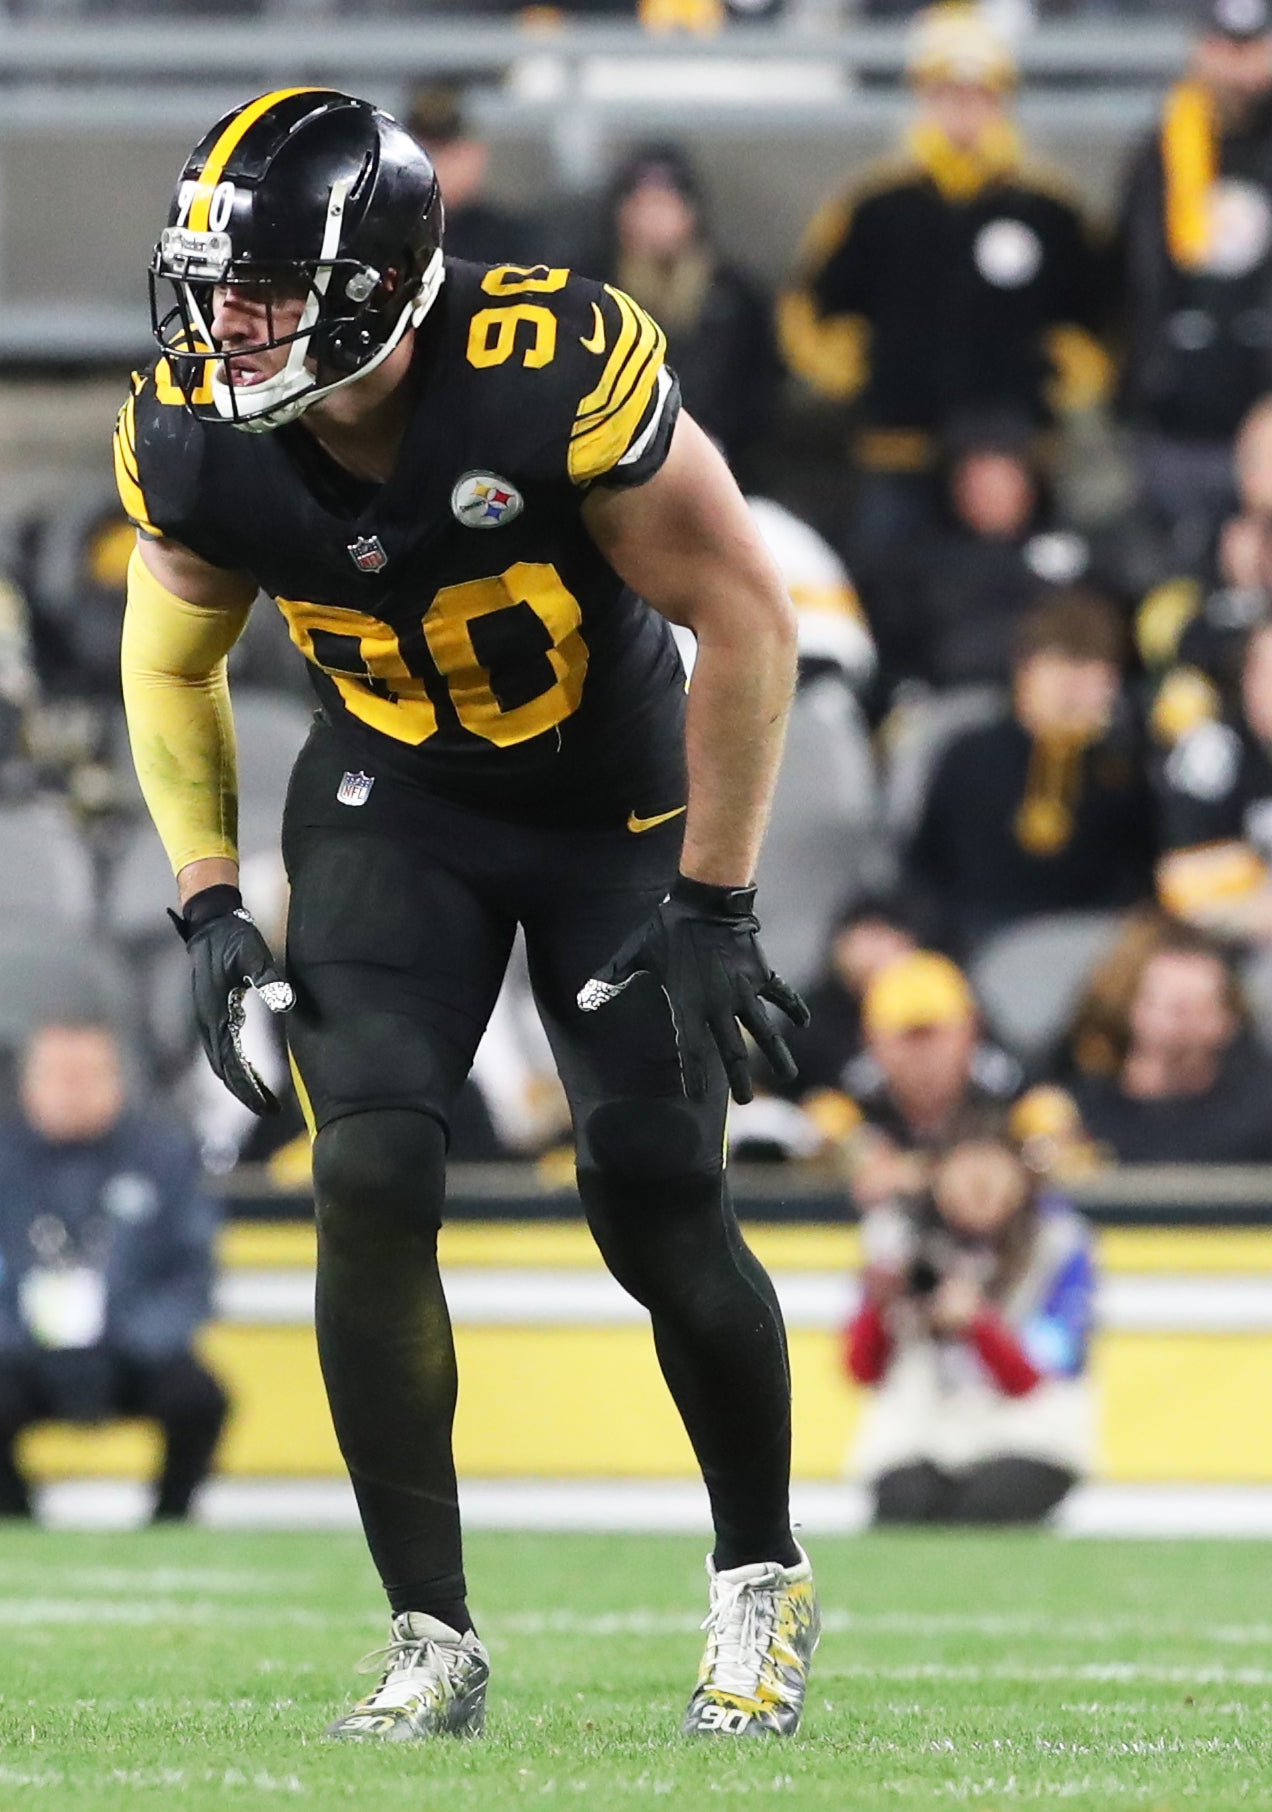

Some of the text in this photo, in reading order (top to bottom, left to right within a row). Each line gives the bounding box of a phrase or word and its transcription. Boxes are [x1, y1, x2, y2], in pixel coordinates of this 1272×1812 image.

[177, 180, 235, 232] 90
[466, 264, 570, 370] 90
[275, 561, 589, 748] 90
[342, 784, 363, 800] NFL
[697, 1704, 751, 1735] 90
